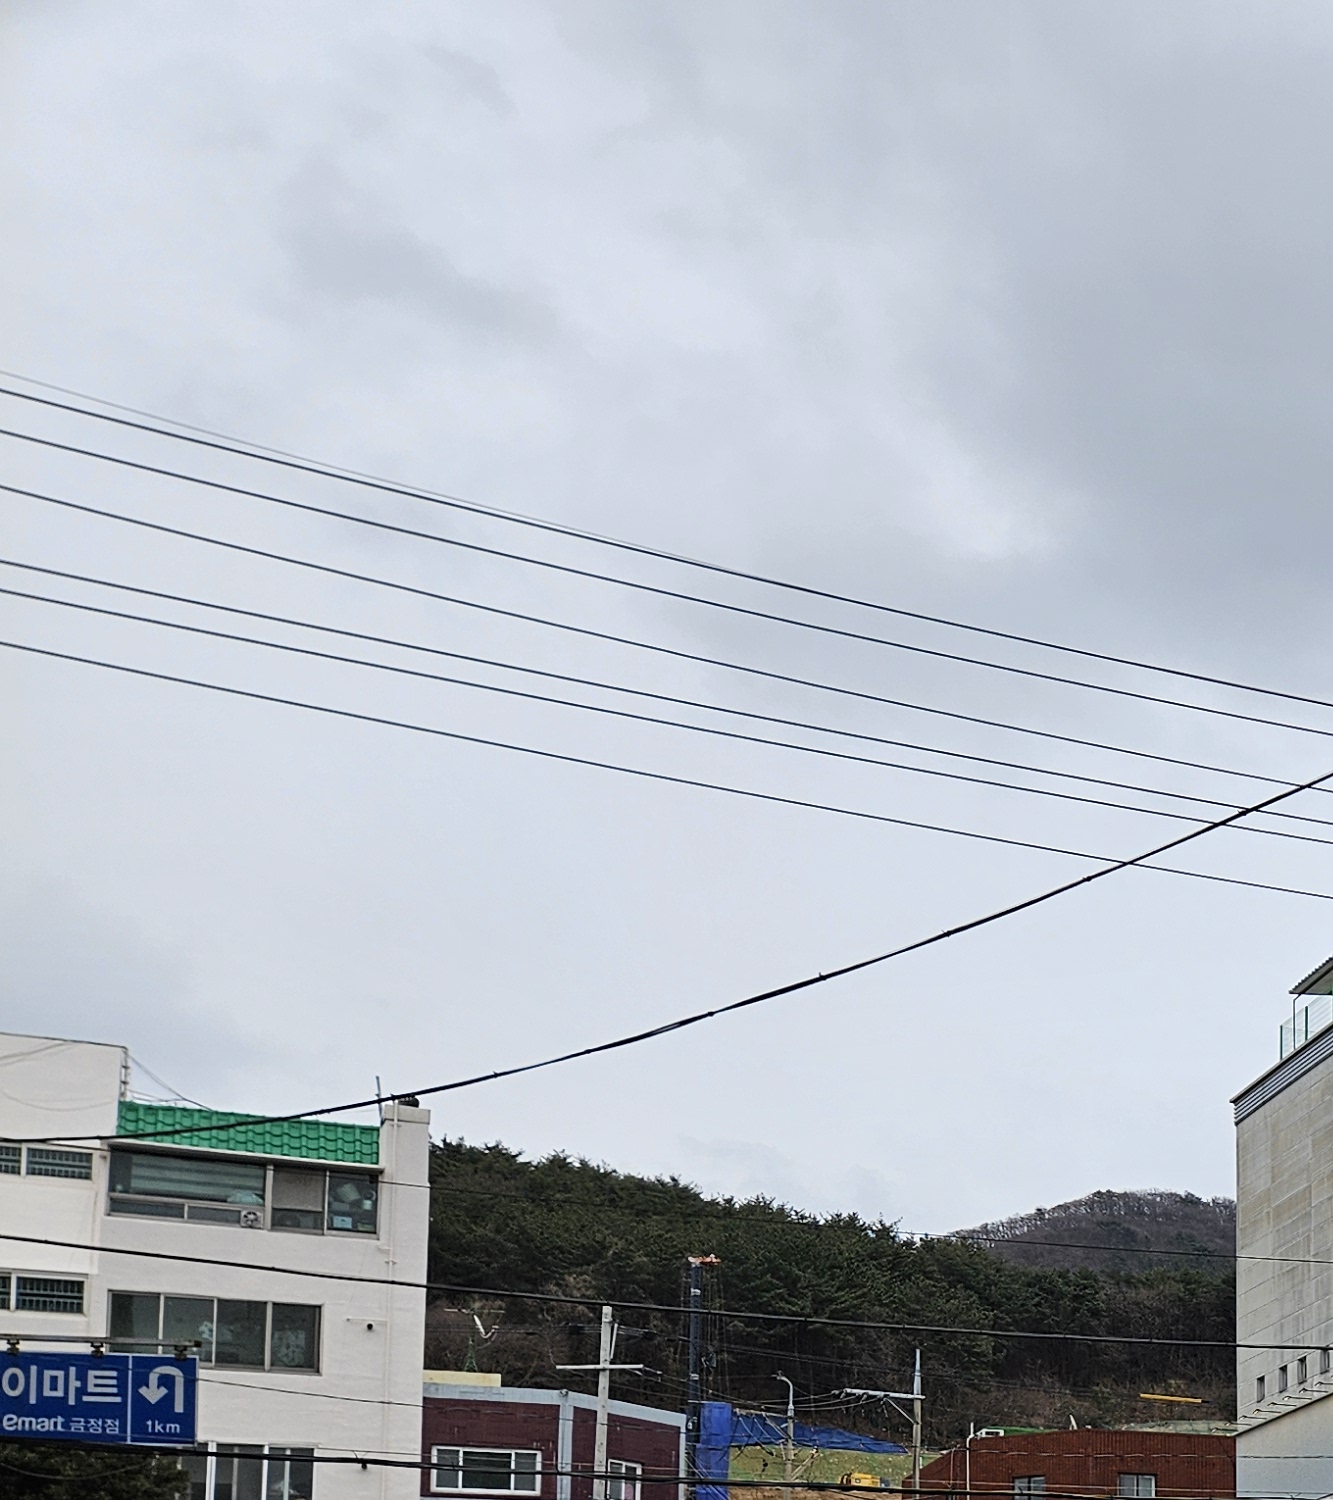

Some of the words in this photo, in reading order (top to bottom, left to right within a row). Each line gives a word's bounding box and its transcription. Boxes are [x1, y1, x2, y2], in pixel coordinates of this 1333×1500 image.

[2, 1365, 122, 1406] 이마트
[2, 1413, 66, 1432] emart
[69, 1417, 119, 1435] 금정점
[146, 1419, 181, 1434] 1km
